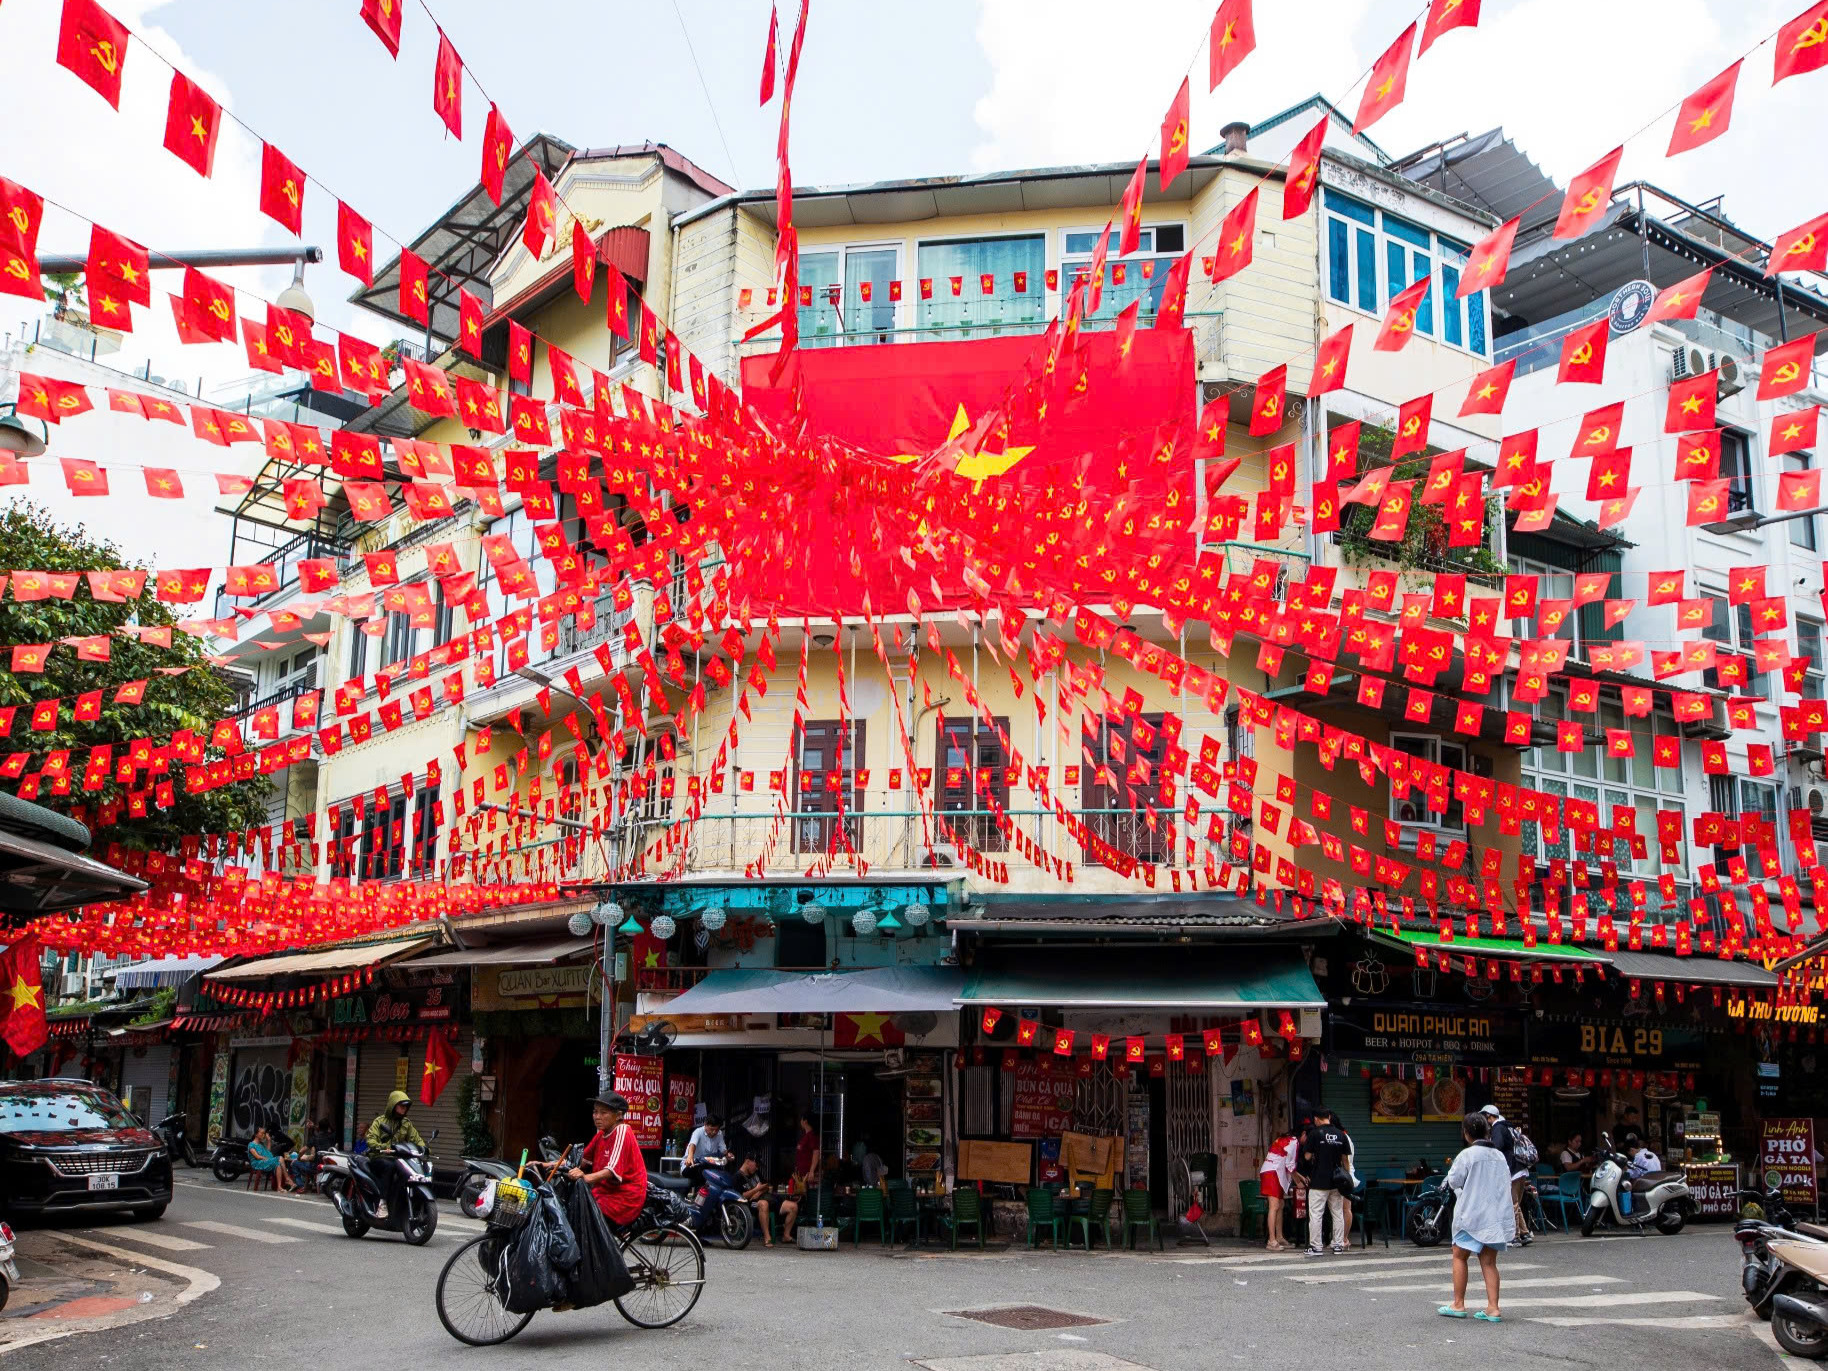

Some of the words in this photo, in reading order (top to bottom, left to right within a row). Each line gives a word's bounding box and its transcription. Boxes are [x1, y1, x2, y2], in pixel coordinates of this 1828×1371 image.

[425, 987, 443, 1006] 35
[334, 997, 367, 1023] BIA
[371, 993, 411, 1023] Bon
[1364, 1036, 1389, 1048] BEER
[1399, 1037, 1433, 1049] HOTPOT
[1443, 1040, 1461, 1052] BBQ
[1470, 1041, 1496, 1052] DRINK
[1579, 1024, 1629, 1054] BIA
[1633, 1027, 1664, 1056] 29
[614, 1074, 633, 1092] BÚN
[633, 1074, 645, 1093] CÁ
[1016, 1076, 1037, 1093] BÚN
[1038, 1077, 1052, 1094] CÁ
[644, 1113, 662, 1128] CÁ
[1048, 1115, 1071, 1131] CÁ
[1762, 1120, 1785, 1138] Linh
[1785, 1120, 1809, 1138] Anh
[1766, 1135, 1807, 1153] PHỞ
[1763, 1152, 1788, 1165] GÀ
[1789, 1155, 1812, 1165] TA
[1783, 1173, 1814, 1187] 40k
[1708, 1181, 1722, 1200] GÀ
